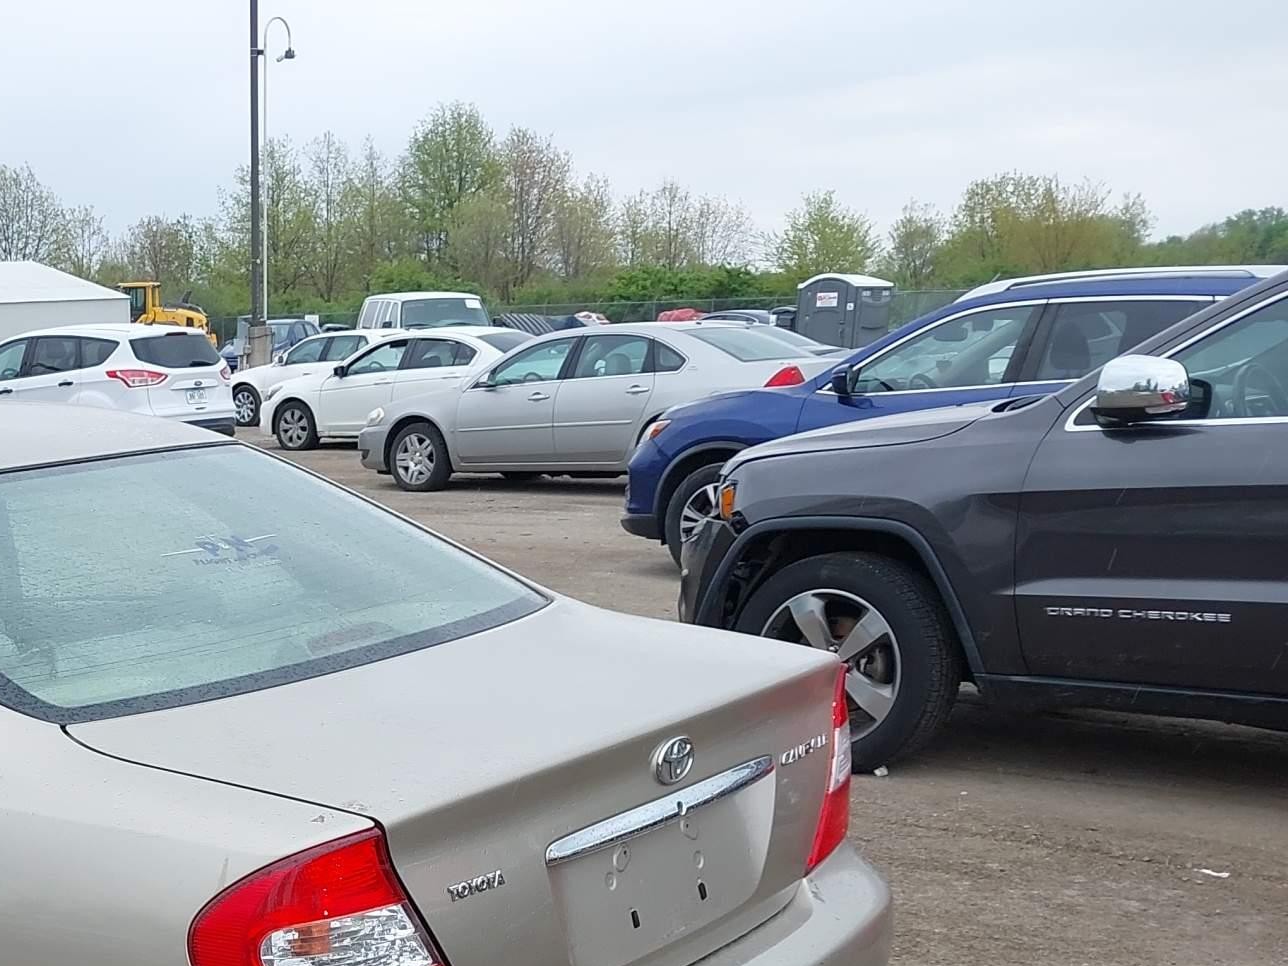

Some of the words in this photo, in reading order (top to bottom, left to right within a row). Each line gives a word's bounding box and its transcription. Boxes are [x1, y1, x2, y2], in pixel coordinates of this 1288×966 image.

[1046, 607, 1114, 617] GRAND
[1117, 609, 1233, 622] CHEROKEE
[447, 869, 506, 902] TOYOTA
